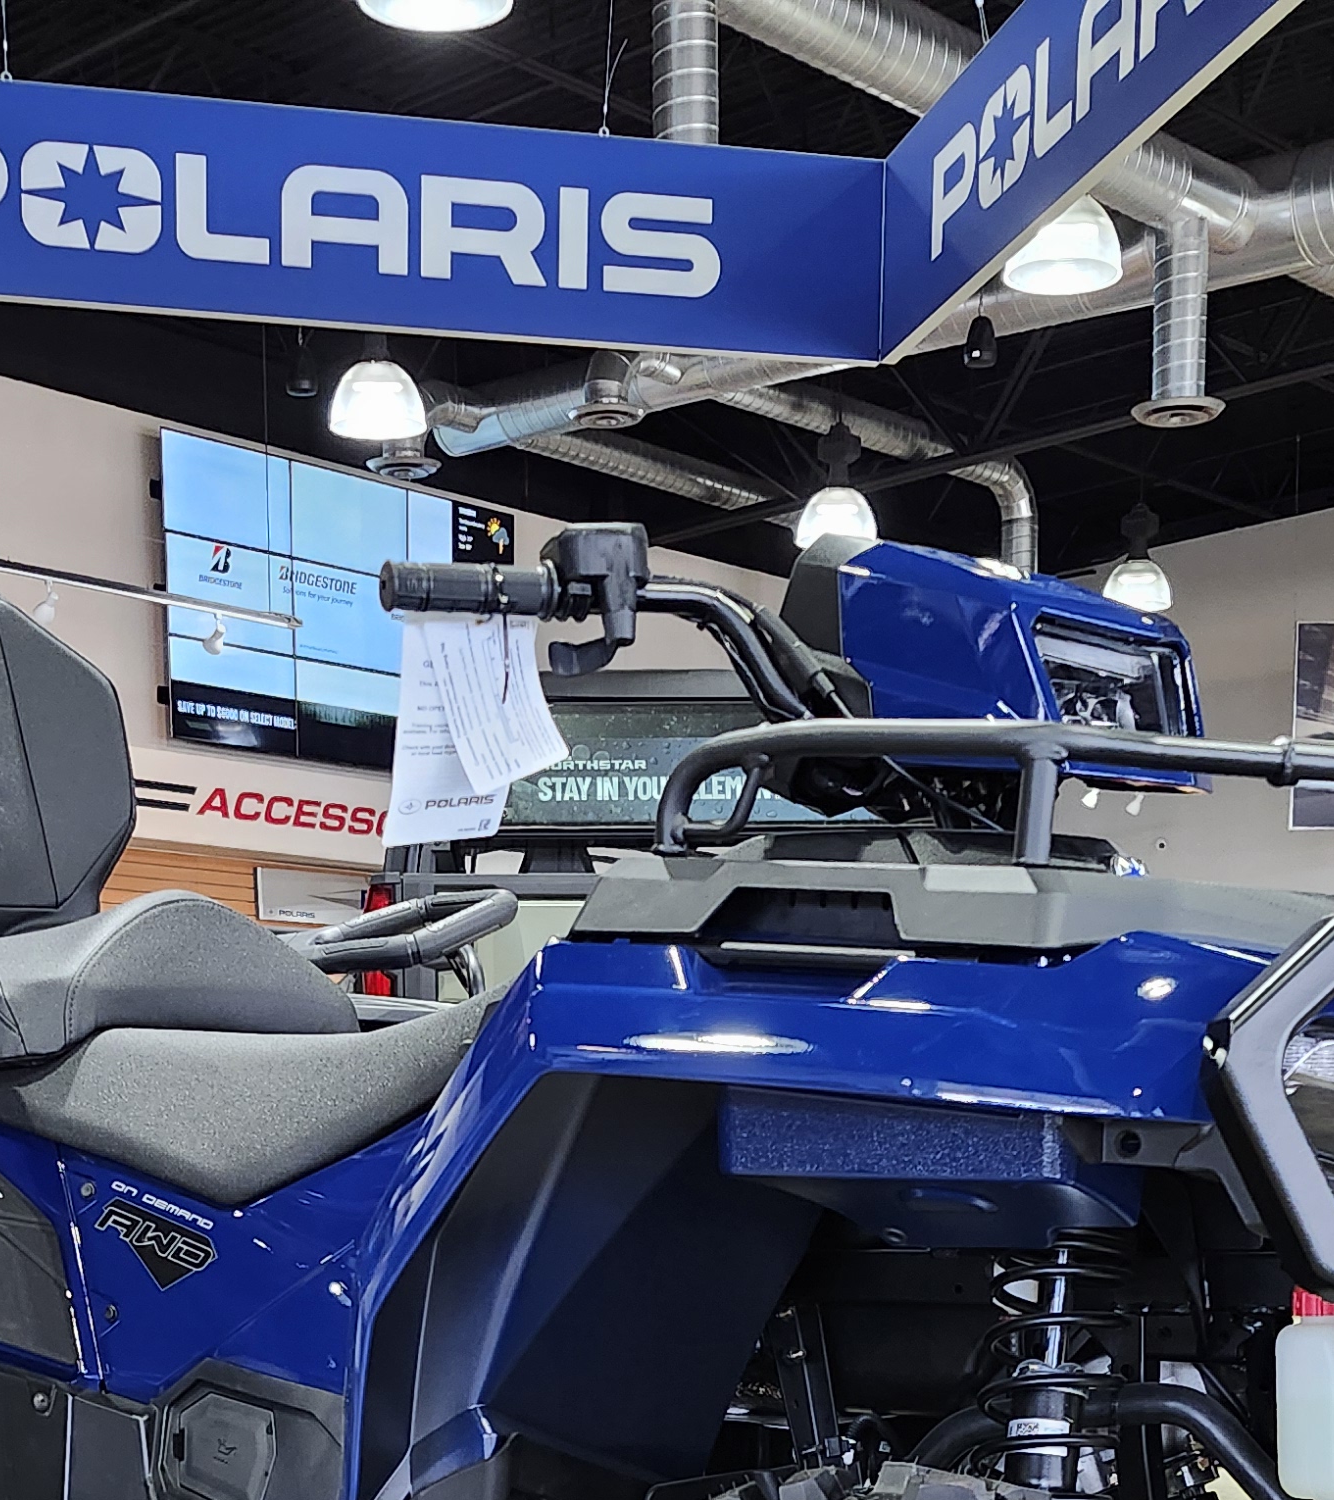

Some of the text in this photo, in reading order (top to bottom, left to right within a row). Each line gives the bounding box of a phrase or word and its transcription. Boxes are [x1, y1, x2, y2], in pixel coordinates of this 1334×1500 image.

[196, 703, 206, 715] UP
[250, 710, 273, 726] SELECT
[551, 759, 647, 771] ORTHSTAR
[538, 776, 591, 801] STAY
[596, 776, 618, 801] IN
[624, 775, 670, 801] YOU
[425, 794, 497, 810] POLARIS
[278, 908, 315, 919] POLARIS
[94, 1206, 216, 1273] AWD
